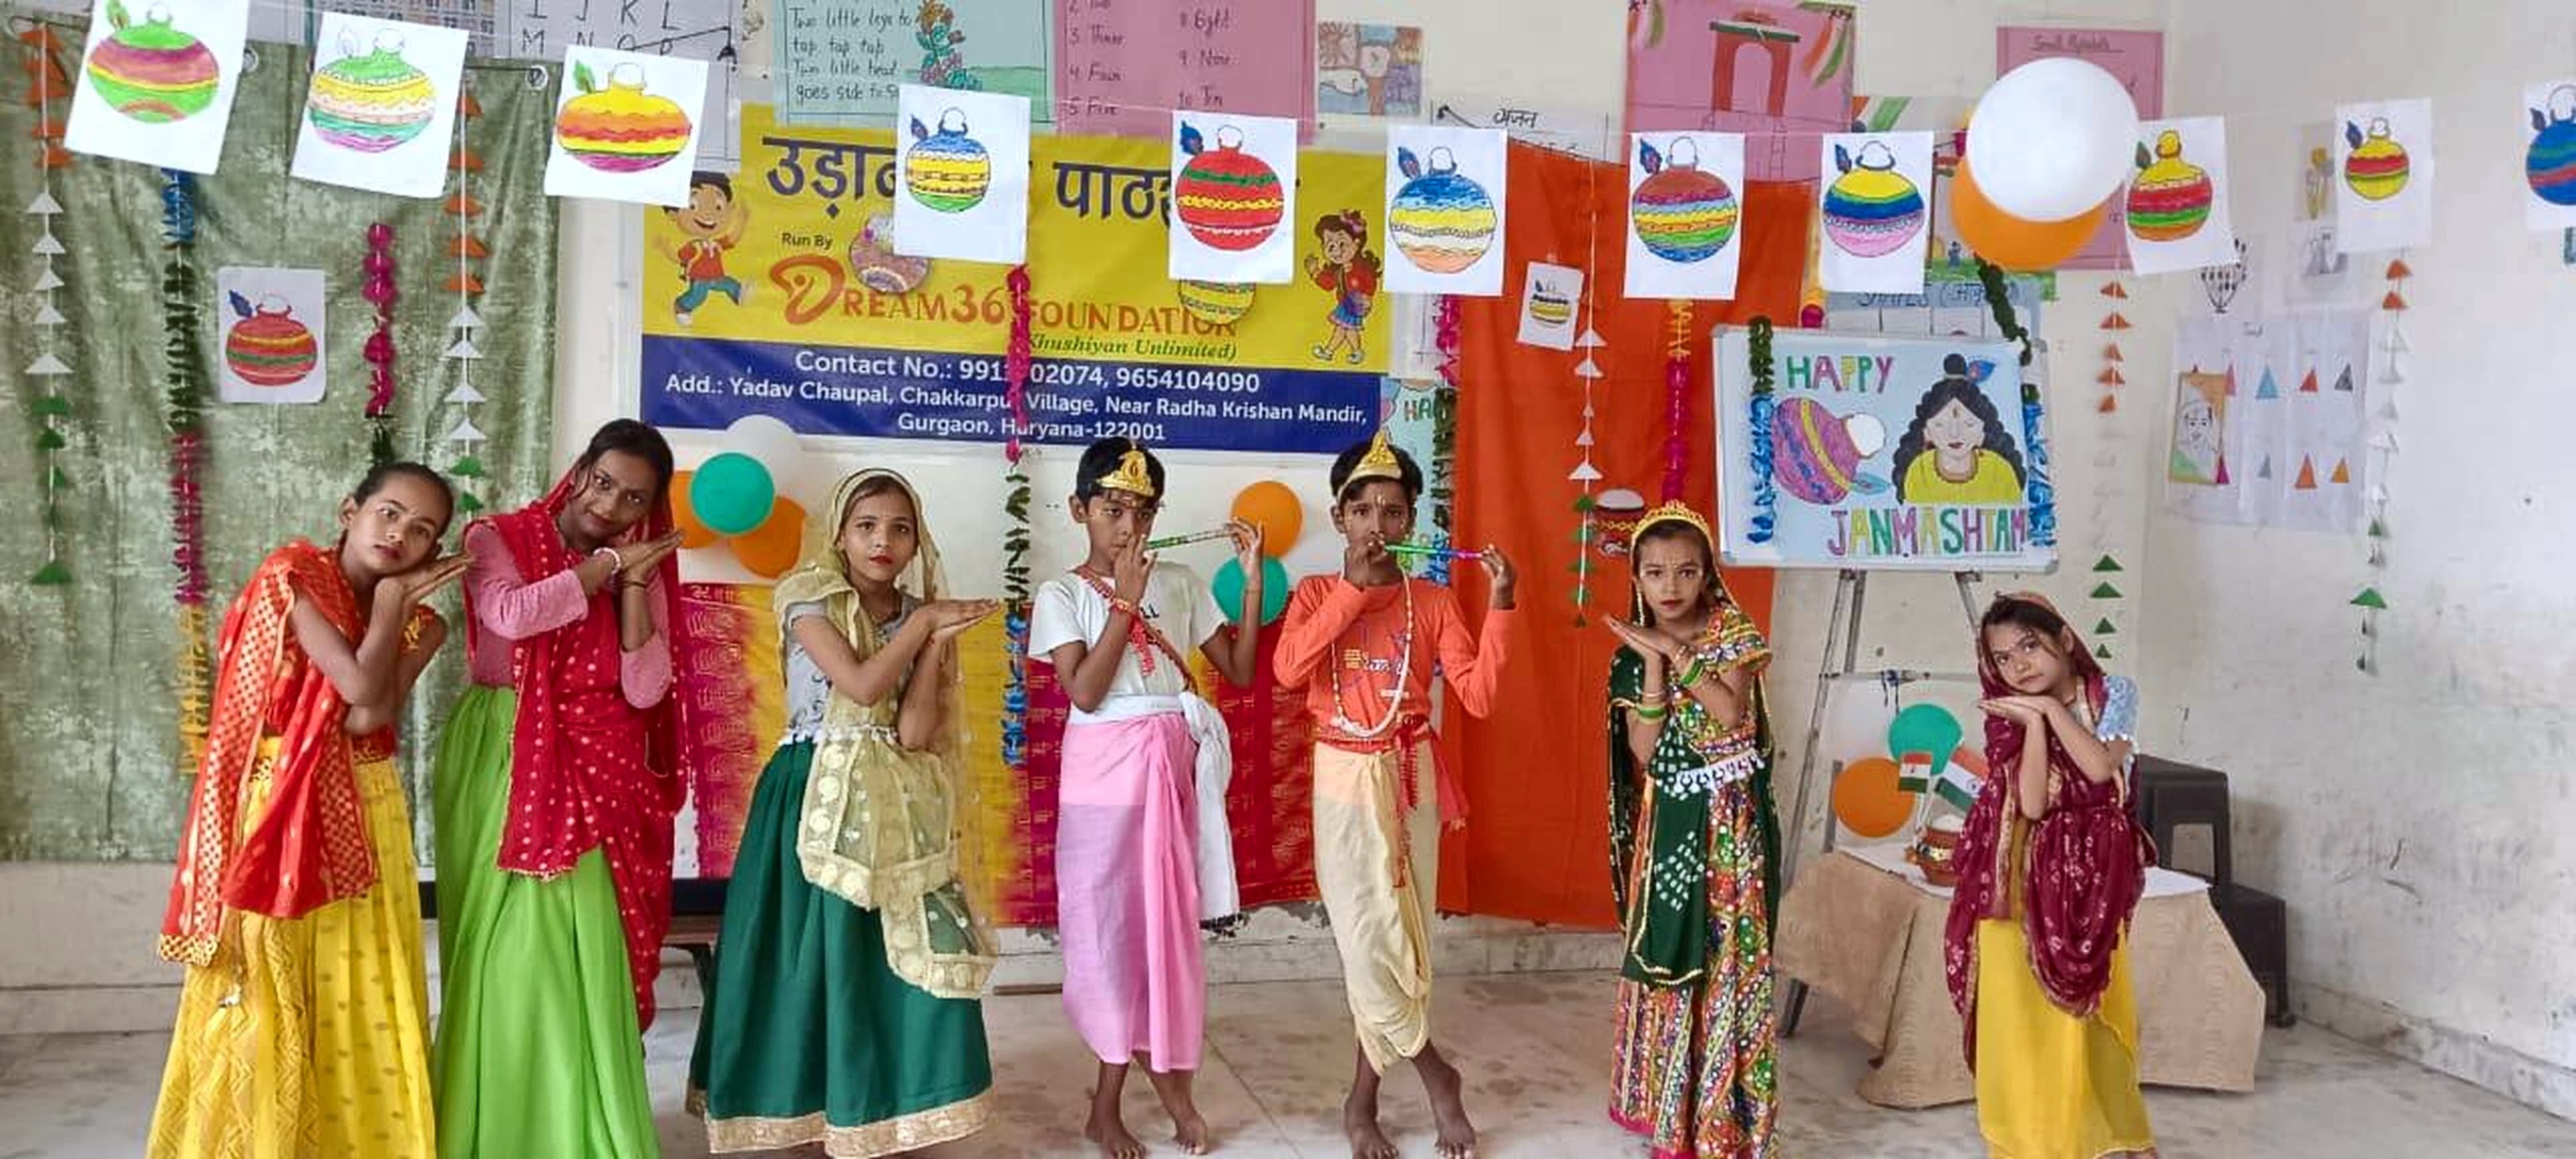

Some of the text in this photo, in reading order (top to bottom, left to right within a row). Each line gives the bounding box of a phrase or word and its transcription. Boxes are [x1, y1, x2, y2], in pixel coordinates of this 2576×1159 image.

[621, 0, 637, 25] K
[661, 0, 682, 31] L
[826, 7, 861, 27] little
[521, 27, 545, 54] M
[830, 58, 861, 74] little
[796, 84, 830, 107] goes
[837, 82, 863, 100] side
[782, 232, 833, 251] Run By
[1135, 339, 1237, 362] Unlimited)
[796, 351, 1260, 392] Contact No.: 99102074, 9654104090
[1786, 355, 1894, 394] HAPPY
[665, 374, 1367, 425] Add.: Yadav Chaupal, Chakkarpu Village, Near Radha Krishan Mandir,
[898, 415, 995, 435] Gurgaon,
[1827, 506, 2027, 556] JANMASHTAM
